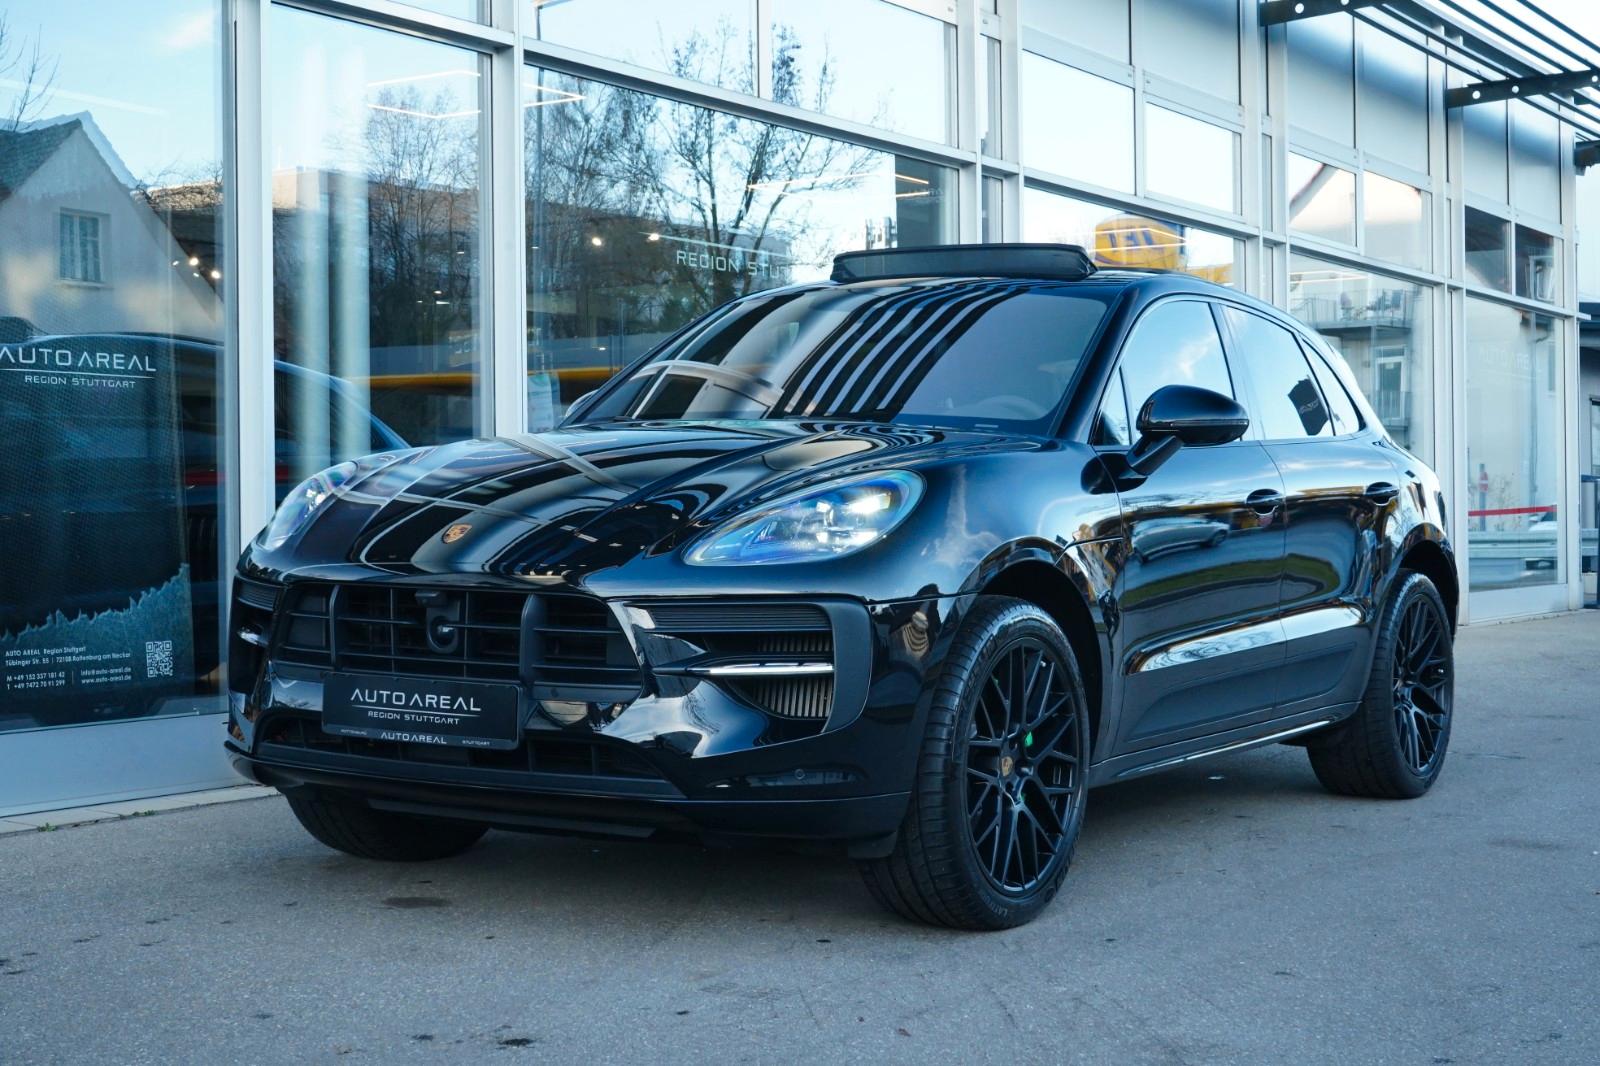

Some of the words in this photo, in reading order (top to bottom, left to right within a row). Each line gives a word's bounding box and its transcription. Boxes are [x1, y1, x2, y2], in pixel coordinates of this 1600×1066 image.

[676, 250, 740, 273] REGION
[25, 375, 67, 385] REGION
[72, 377, 136, 389] STUTTGART
[5, 649, 22, 657] AUTO
[43, 647, 63, 656] Region
[63, 646, 87, 654] Stuttgart
[367, 710, 401, 720] REGION
[404, 714, 460, 725] STUTTGART
